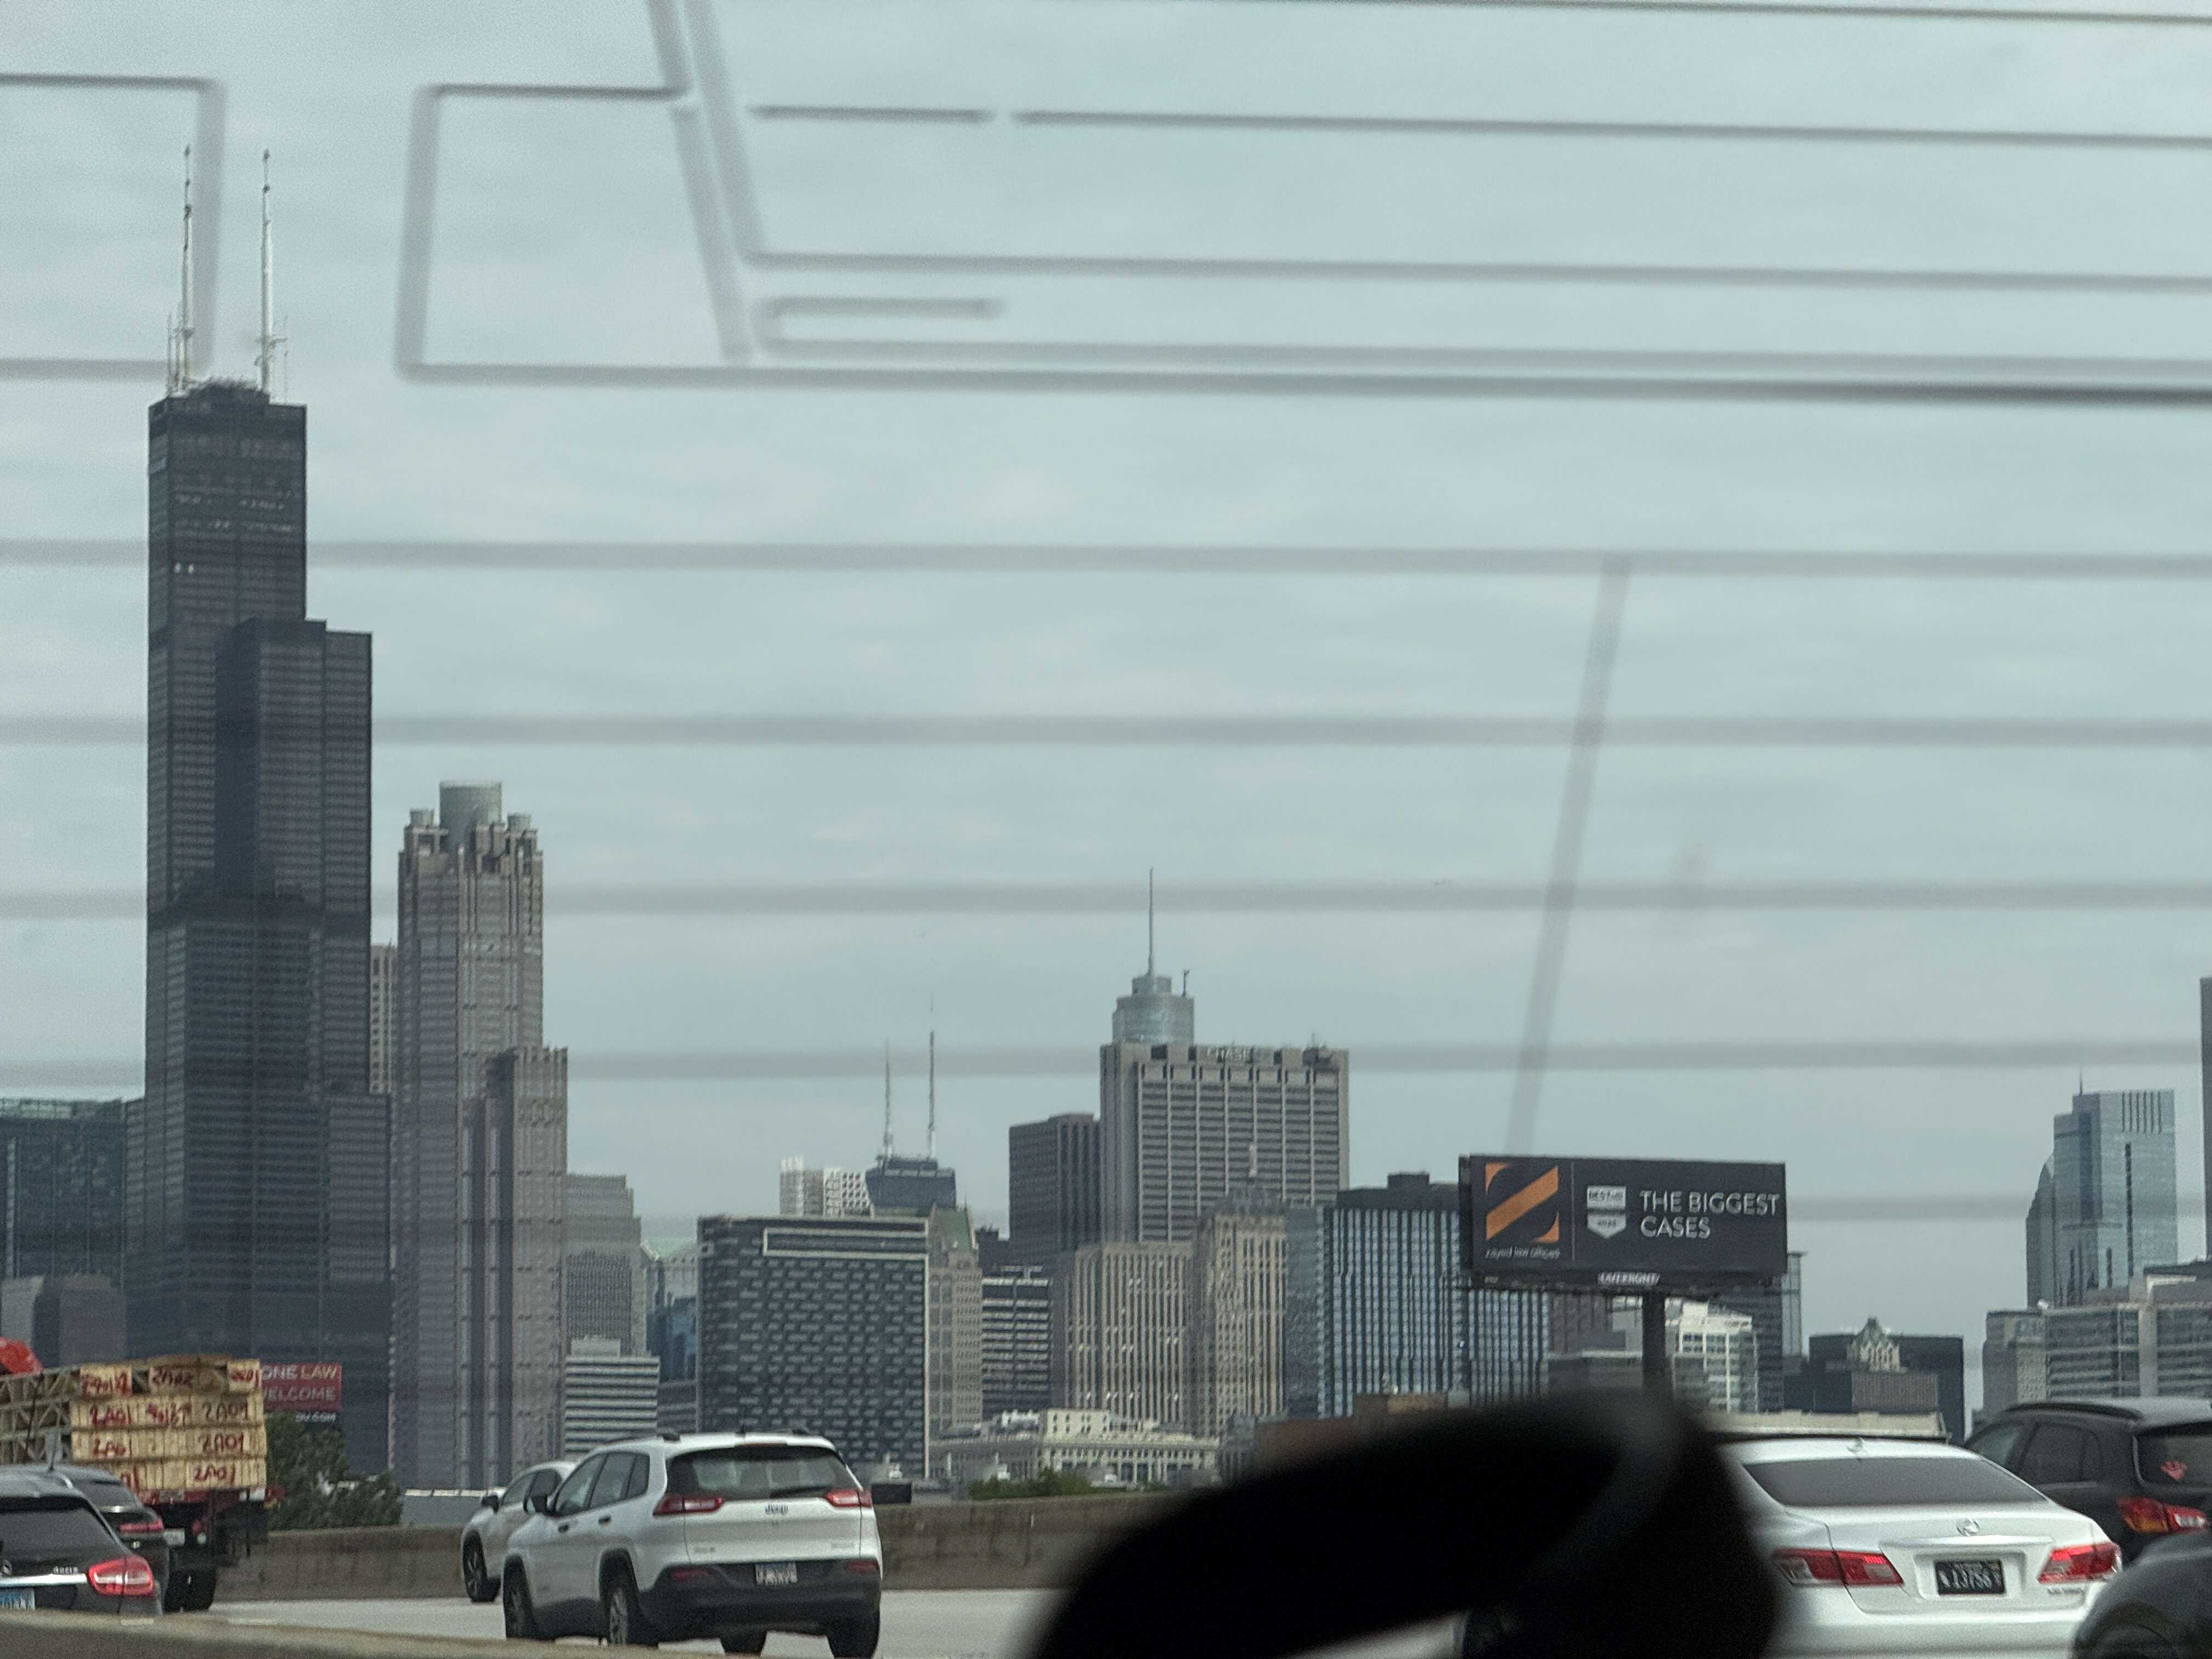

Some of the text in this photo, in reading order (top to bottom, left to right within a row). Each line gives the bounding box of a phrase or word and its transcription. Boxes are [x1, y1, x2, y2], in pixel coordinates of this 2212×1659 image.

[1639, 1189, 1683, 1214] THE
[1688, 1191, 1780, 1216] BIGGEST
[1640, 1215, 1711, 1239] CASES
[301, 1364, 338, 1380] LAW
